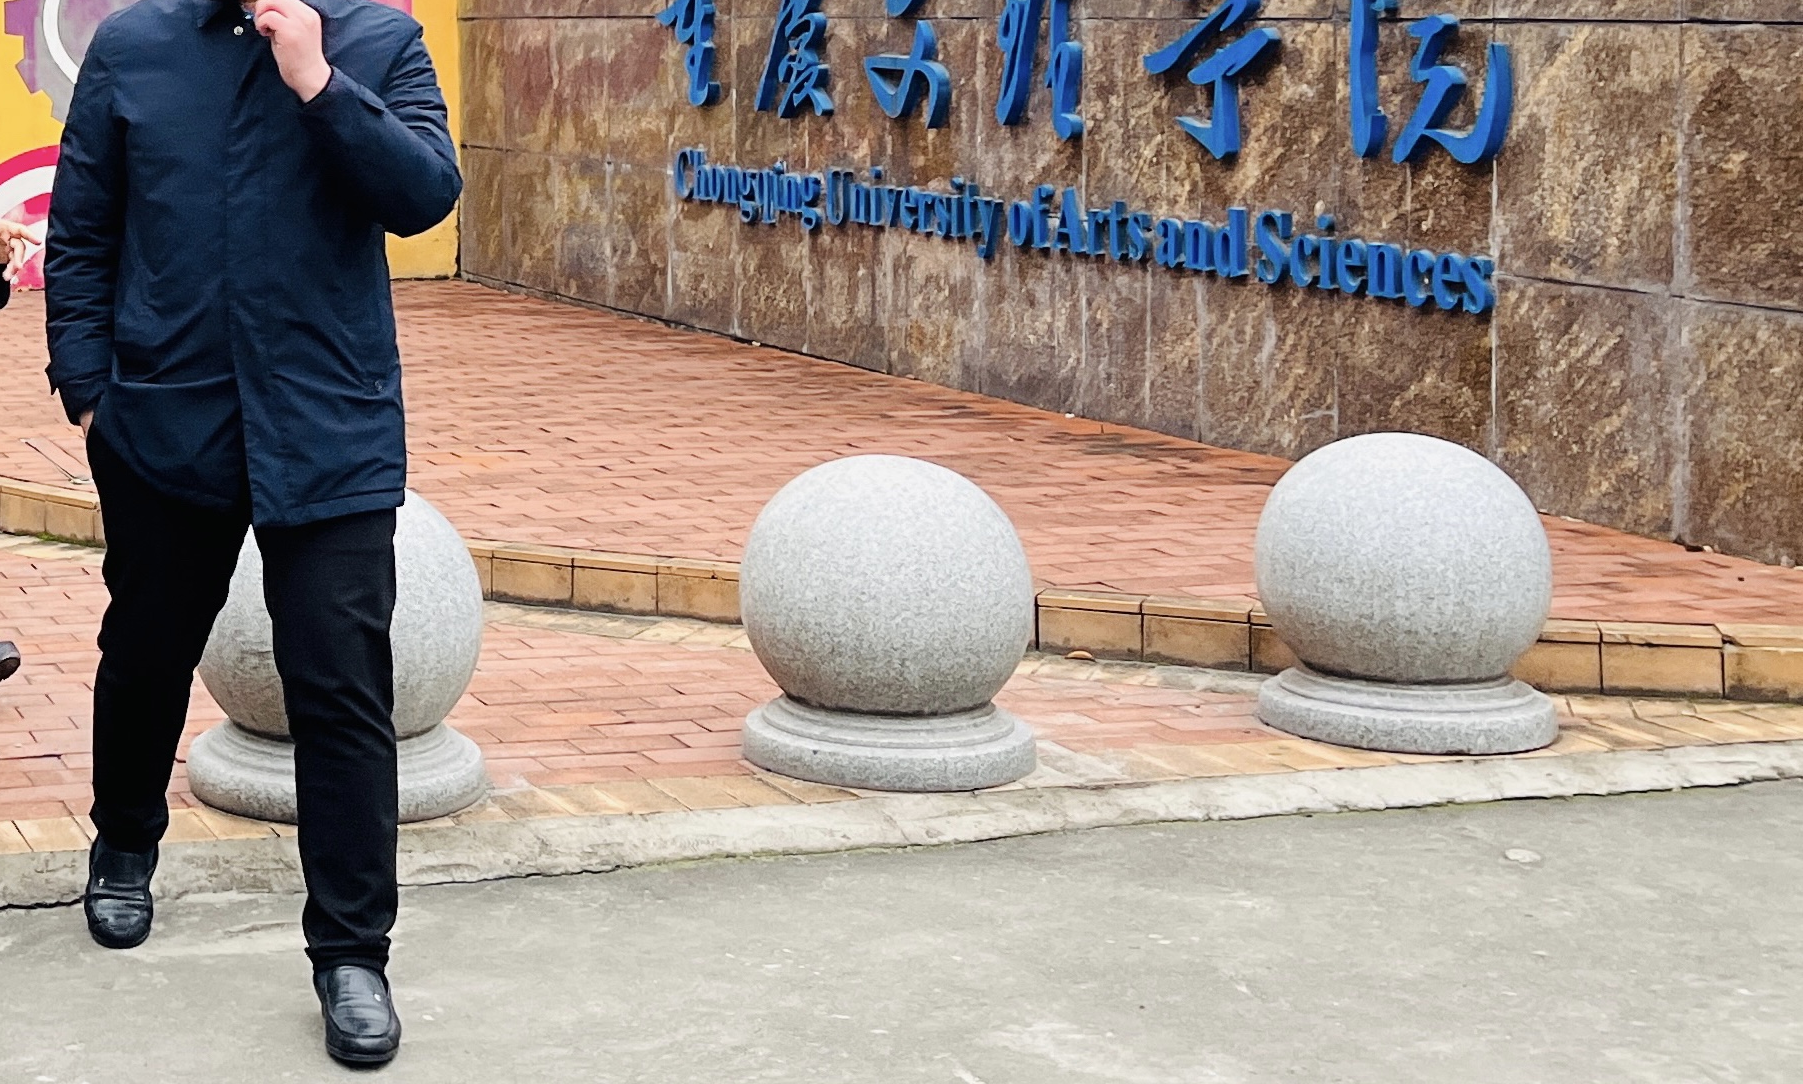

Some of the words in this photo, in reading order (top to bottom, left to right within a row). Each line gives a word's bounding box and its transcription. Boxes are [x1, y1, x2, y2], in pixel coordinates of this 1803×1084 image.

[673, 147, 822, 229] Chongqing
[826, 165, 1003, 258] University
[1008, 184, 1055, 249] of
[1054, 186, 1150, 261] Arts
[1155, 207, 1248, 278] and
[1256, 208, 1496, 315] Sciences
